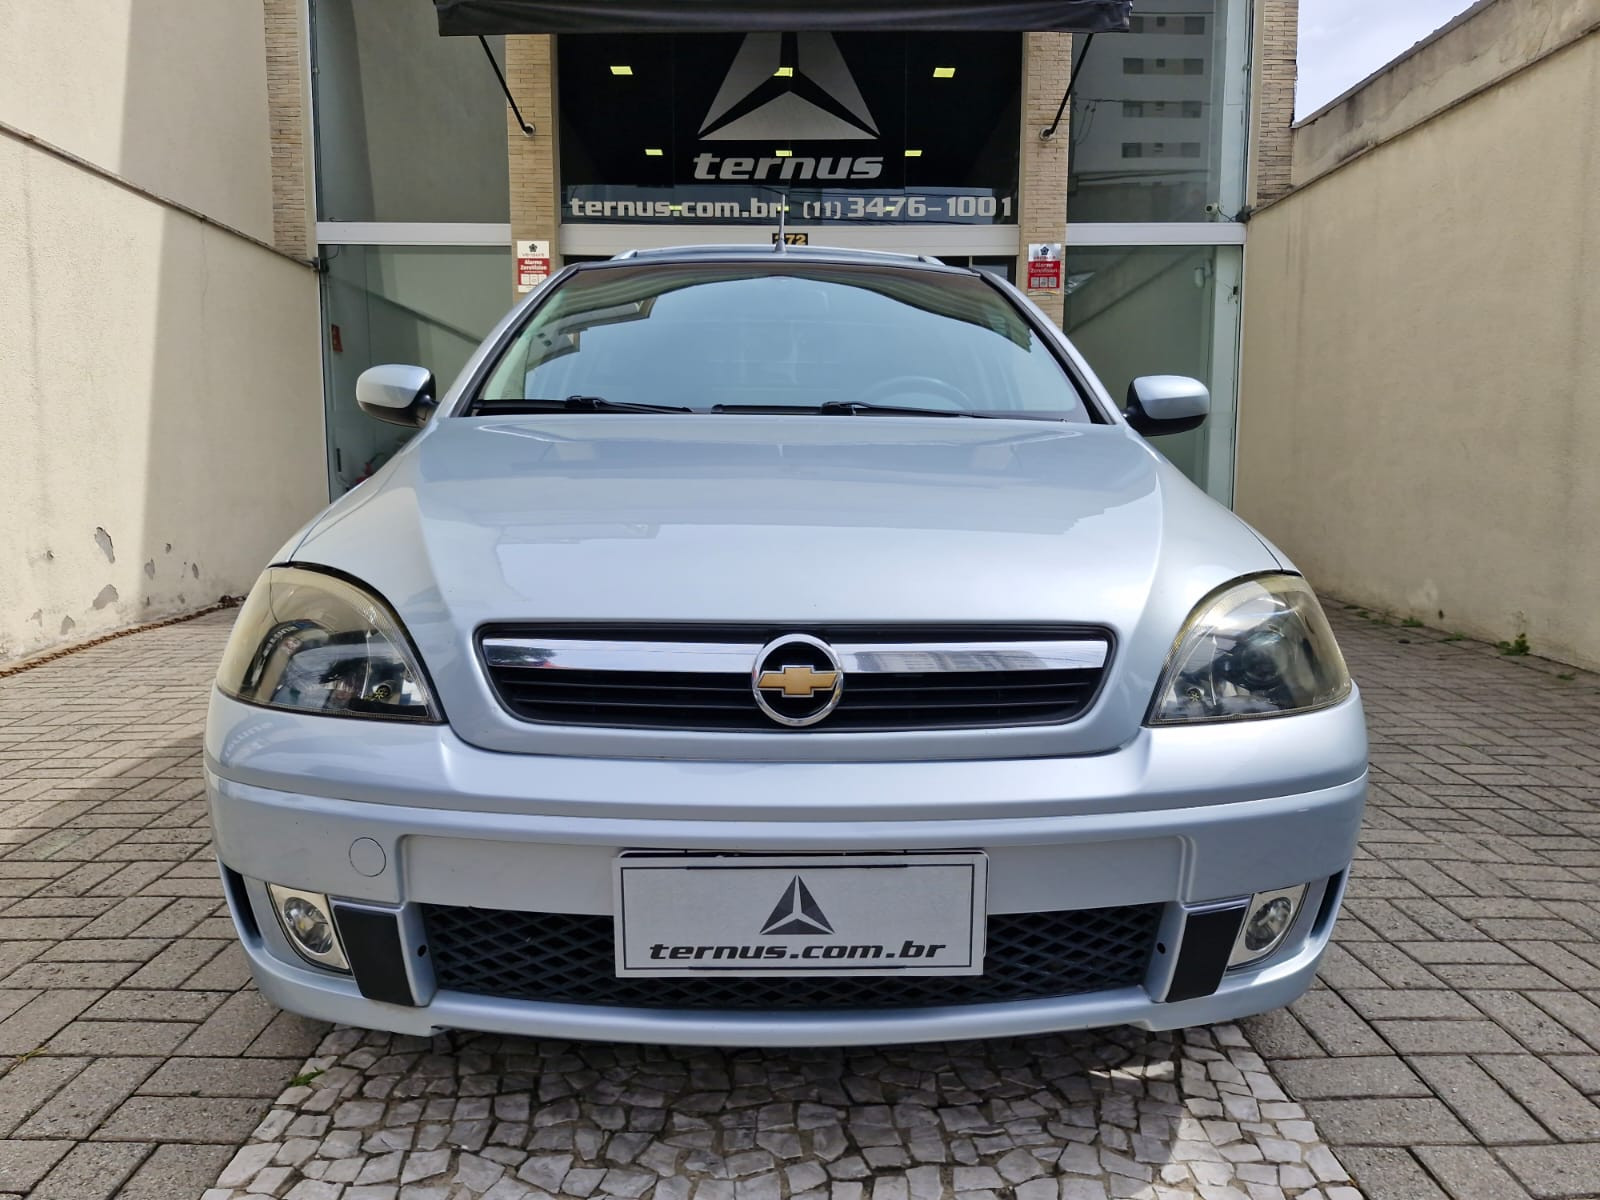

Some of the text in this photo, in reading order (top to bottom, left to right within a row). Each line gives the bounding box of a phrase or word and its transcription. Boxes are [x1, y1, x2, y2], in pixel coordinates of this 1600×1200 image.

[693, 152, 884, 180] ternus
[570, 196, 1012, 219] ternus.com.br (11) 3476-1001
[774, 234, 806, 246] 72
[650, 940, 947, 959] ternus.com.br
